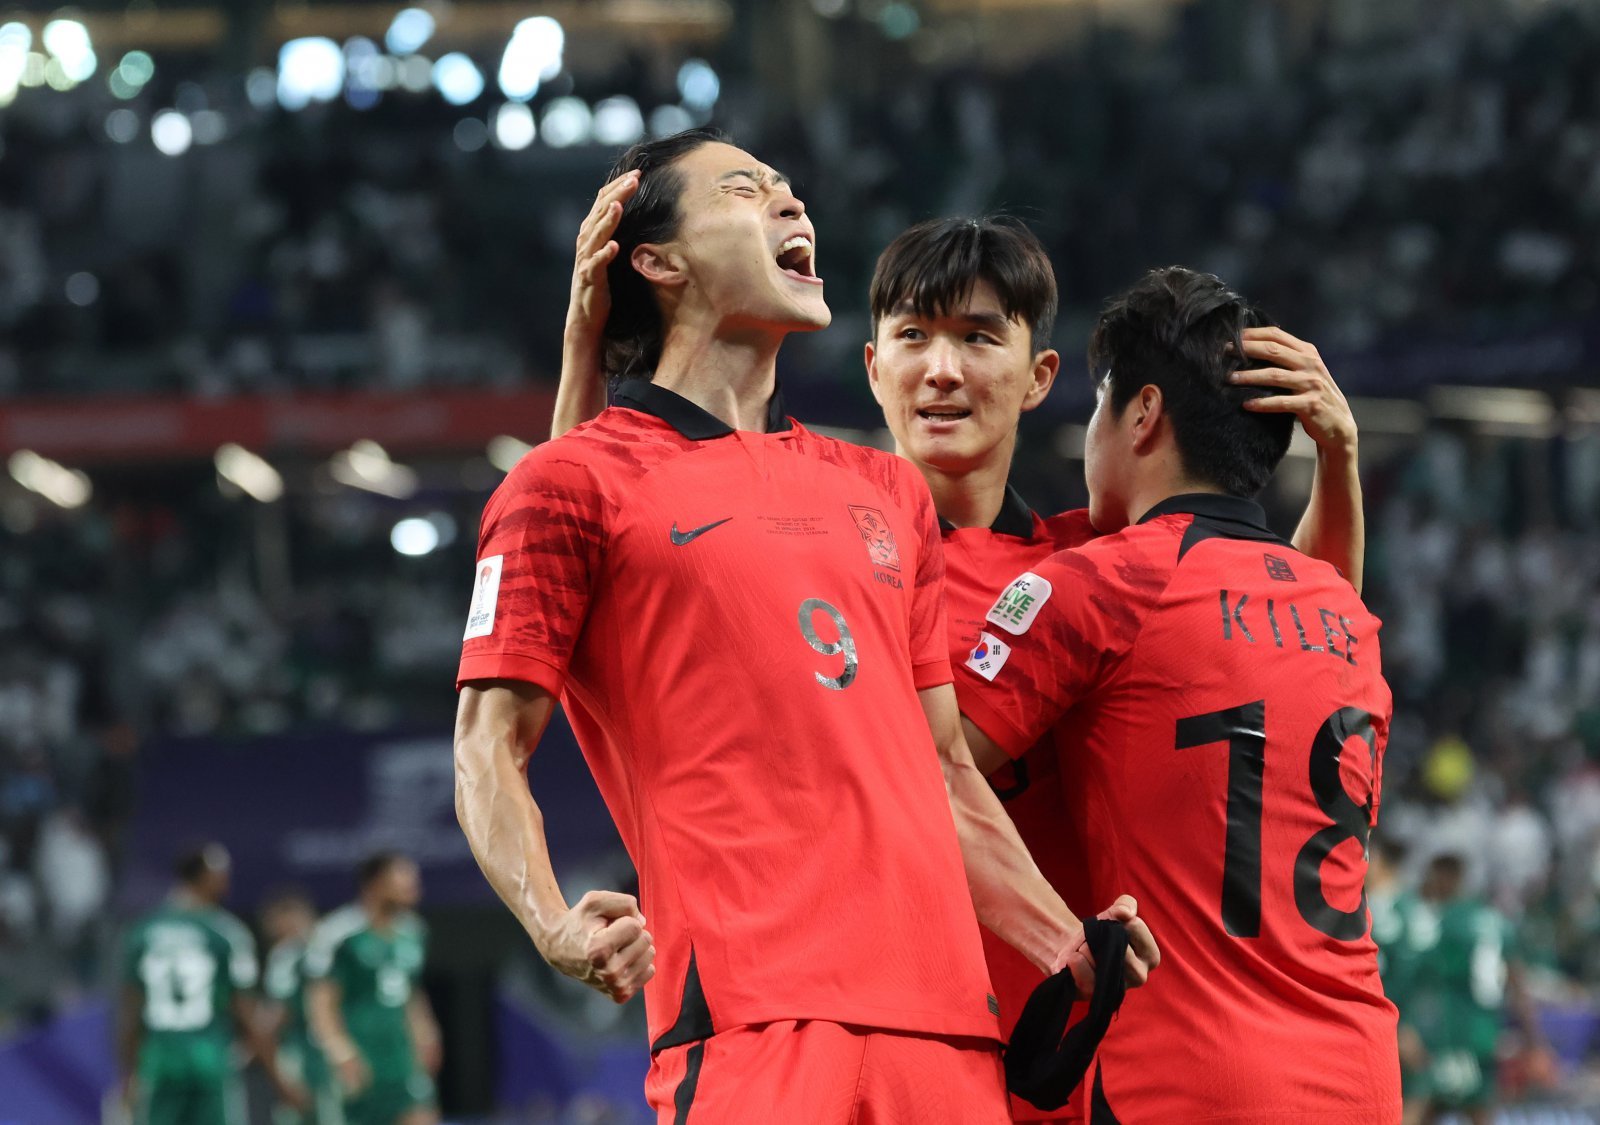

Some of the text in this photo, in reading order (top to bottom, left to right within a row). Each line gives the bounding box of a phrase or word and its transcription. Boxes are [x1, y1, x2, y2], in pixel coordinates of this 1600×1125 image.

[874, 570, 903, 591] KOREA
[1013, 580, 1030, 591] AFC
[1002, 588, 1036, 612] LIVE
[797, 597, 858, 690] 9
[1175, 699, 1377, 942] 18
